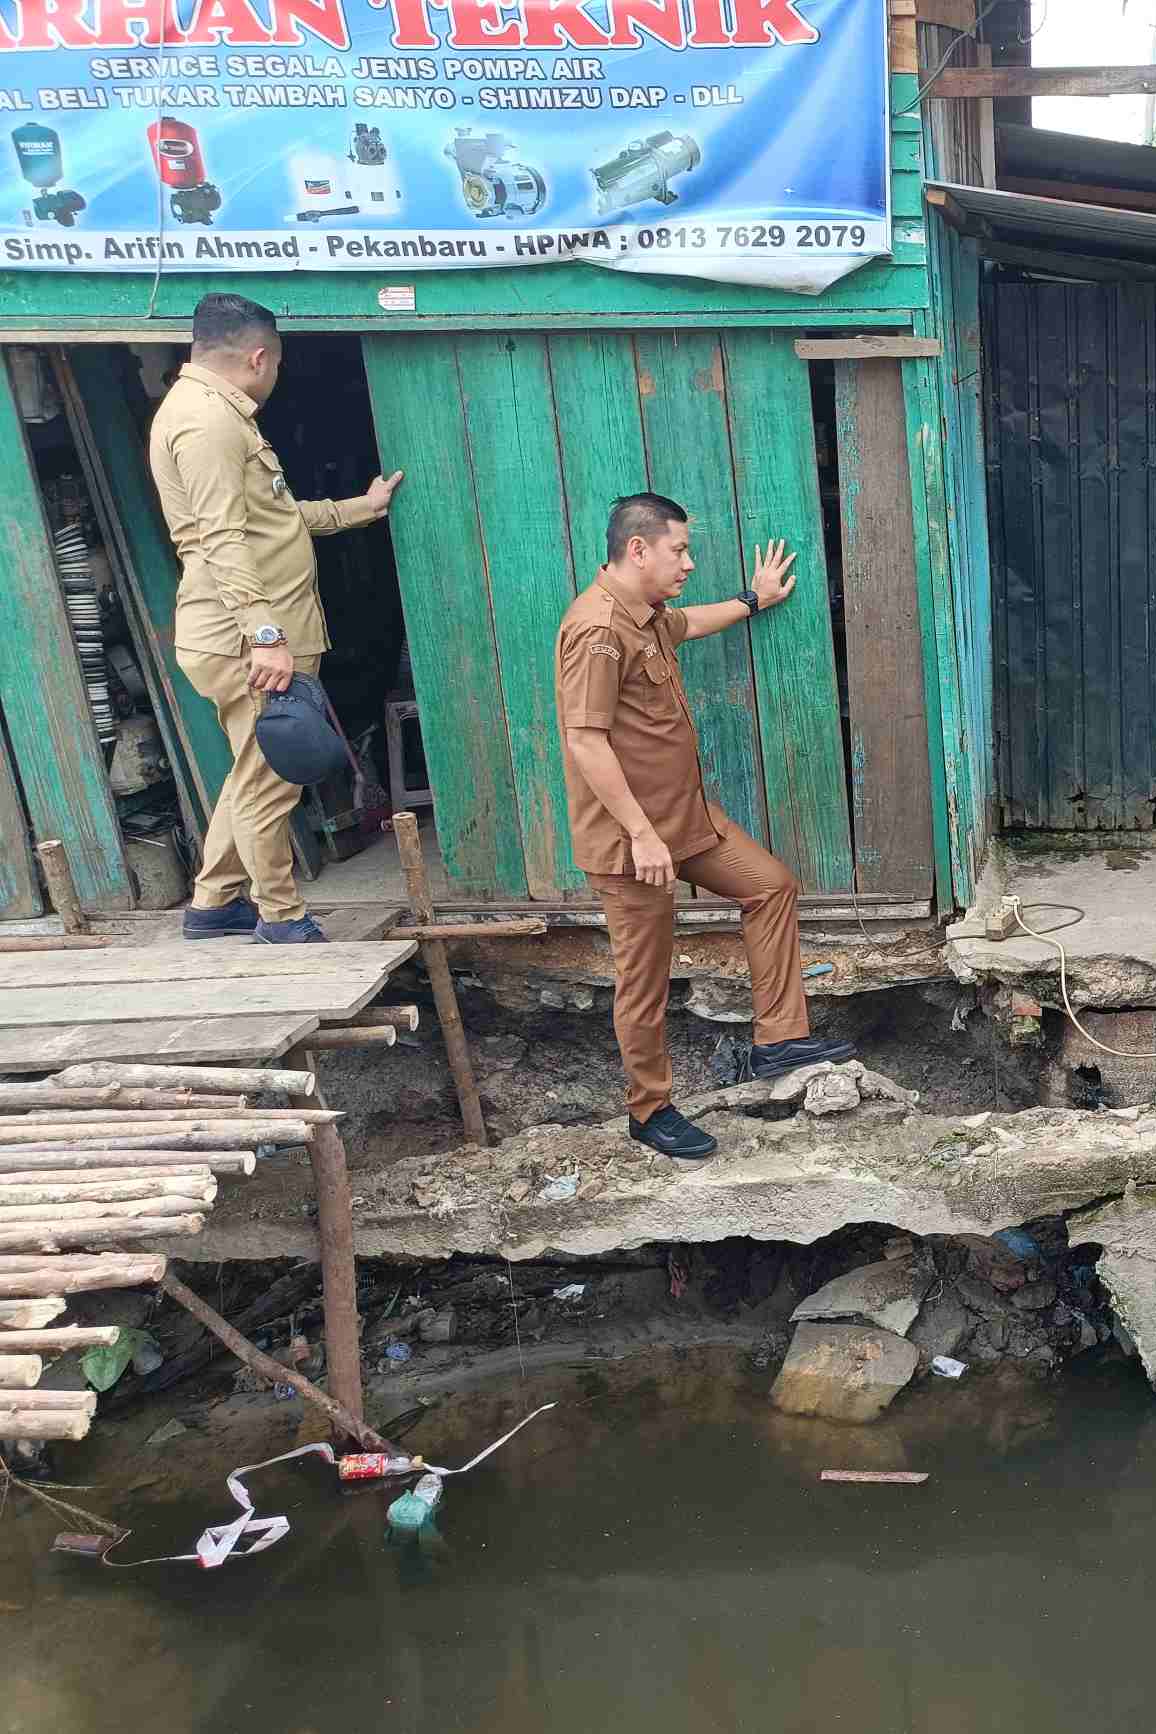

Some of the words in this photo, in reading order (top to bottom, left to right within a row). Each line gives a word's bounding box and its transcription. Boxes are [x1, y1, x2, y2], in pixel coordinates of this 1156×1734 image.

[0, 0, 352, 50] RHAN
[367, 0, 820, 50] TEKNIK
[90, 56, 220, 80] SERVICE
[226, 55, 345, 78] SEGALA
[352, 57, 437, 80] JENIS
[443, 58, 546, 80] POMPA
[552, 58, 606, 80] AIR
[37, 87, 109, 110] BELI
[112, 86, 220, 109] TUKAR
[223, 85, 348, 108] TAMBAH
[353, 87, 457, 109] SANYO
[479, 87, 602, 109] SHIMIZU
[608, 86, 667, 108] DAP
[691, 86, 744, 107] DLL
[4, 238, 93, 265] Simp.
[103, 236, 185, 260] Arifin
[195, 235, 299, 259] Ahmad
[326, 235, 488, 258] Pekanbaru
[638, 227, 706, 250] 0813
[716, 225, 785, 248] 7629
[796, 225, 866, 248] 2079
